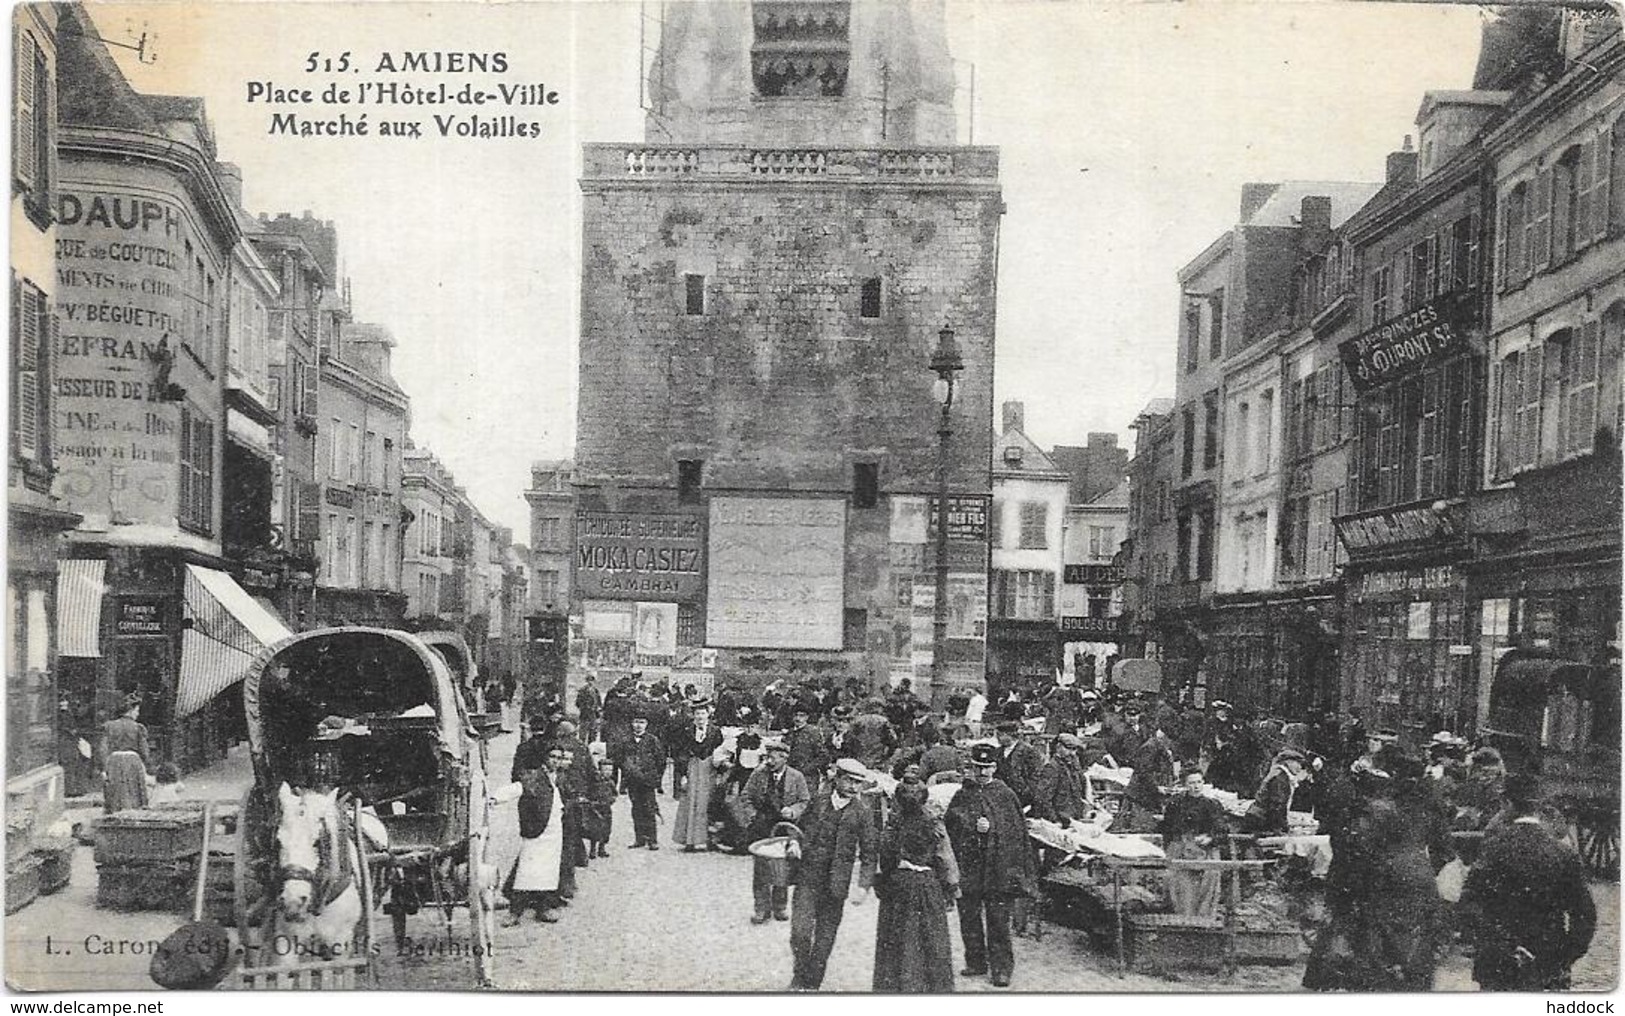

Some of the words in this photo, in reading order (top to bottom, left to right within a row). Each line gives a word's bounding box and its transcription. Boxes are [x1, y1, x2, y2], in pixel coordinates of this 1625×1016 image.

[1373, 332, 1432, 372] DUPONT
[122, 382, 142, 400] DE
[578, 544, 631, 570] MOKA
[634, 546, 700, 573] CASIEZ
[601, 577, 679, 592] CAMBRAI
